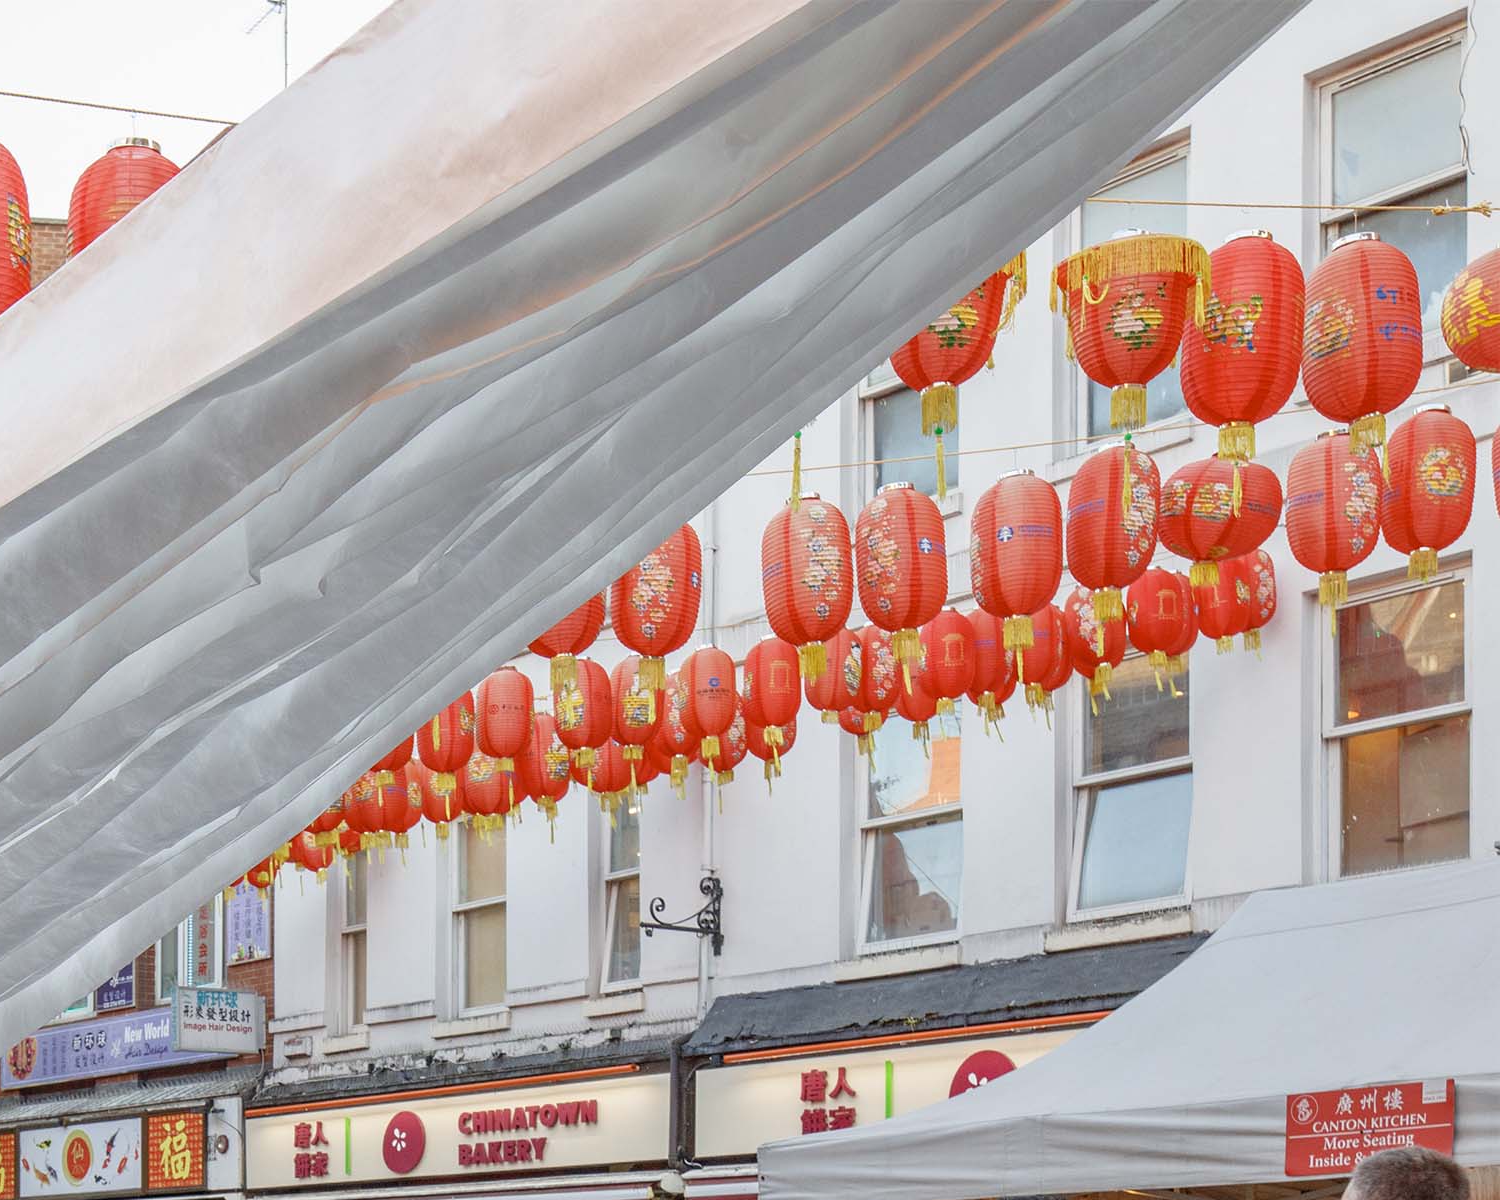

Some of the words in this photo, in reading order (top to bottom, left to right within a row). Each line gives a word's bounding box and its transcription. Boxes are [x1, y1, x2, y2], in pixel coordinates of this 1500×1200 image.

[124, 1026, 142, 1044] New
[144, 1017, 170, 1041] World
[183, 1022, 207, 1032] Image
[209, 1023, 224, 1031] Hair
[226, 1024, 252, 1034] Design
[800, 1066, 856, 1104] 唐人
[1334, 1087, 1405, 1116] 廣州樓
[458, 1100, 598, 1135] CHINATOWN
[1312, 1118, 1367, 1134] CANTON
[1371, 1113, 1427, 1130] KITCHEN
[294, 1120, 328, 1148] 唐人
[1323, 1136, 1359, 1150] More
[1363, 1132, 1414, 1148] Seating
[160, 1119, 191, 1180] 福
[458, 1137, 548, 1166] BAKERY
[1309, 1152, 1351, 1168] Inside
